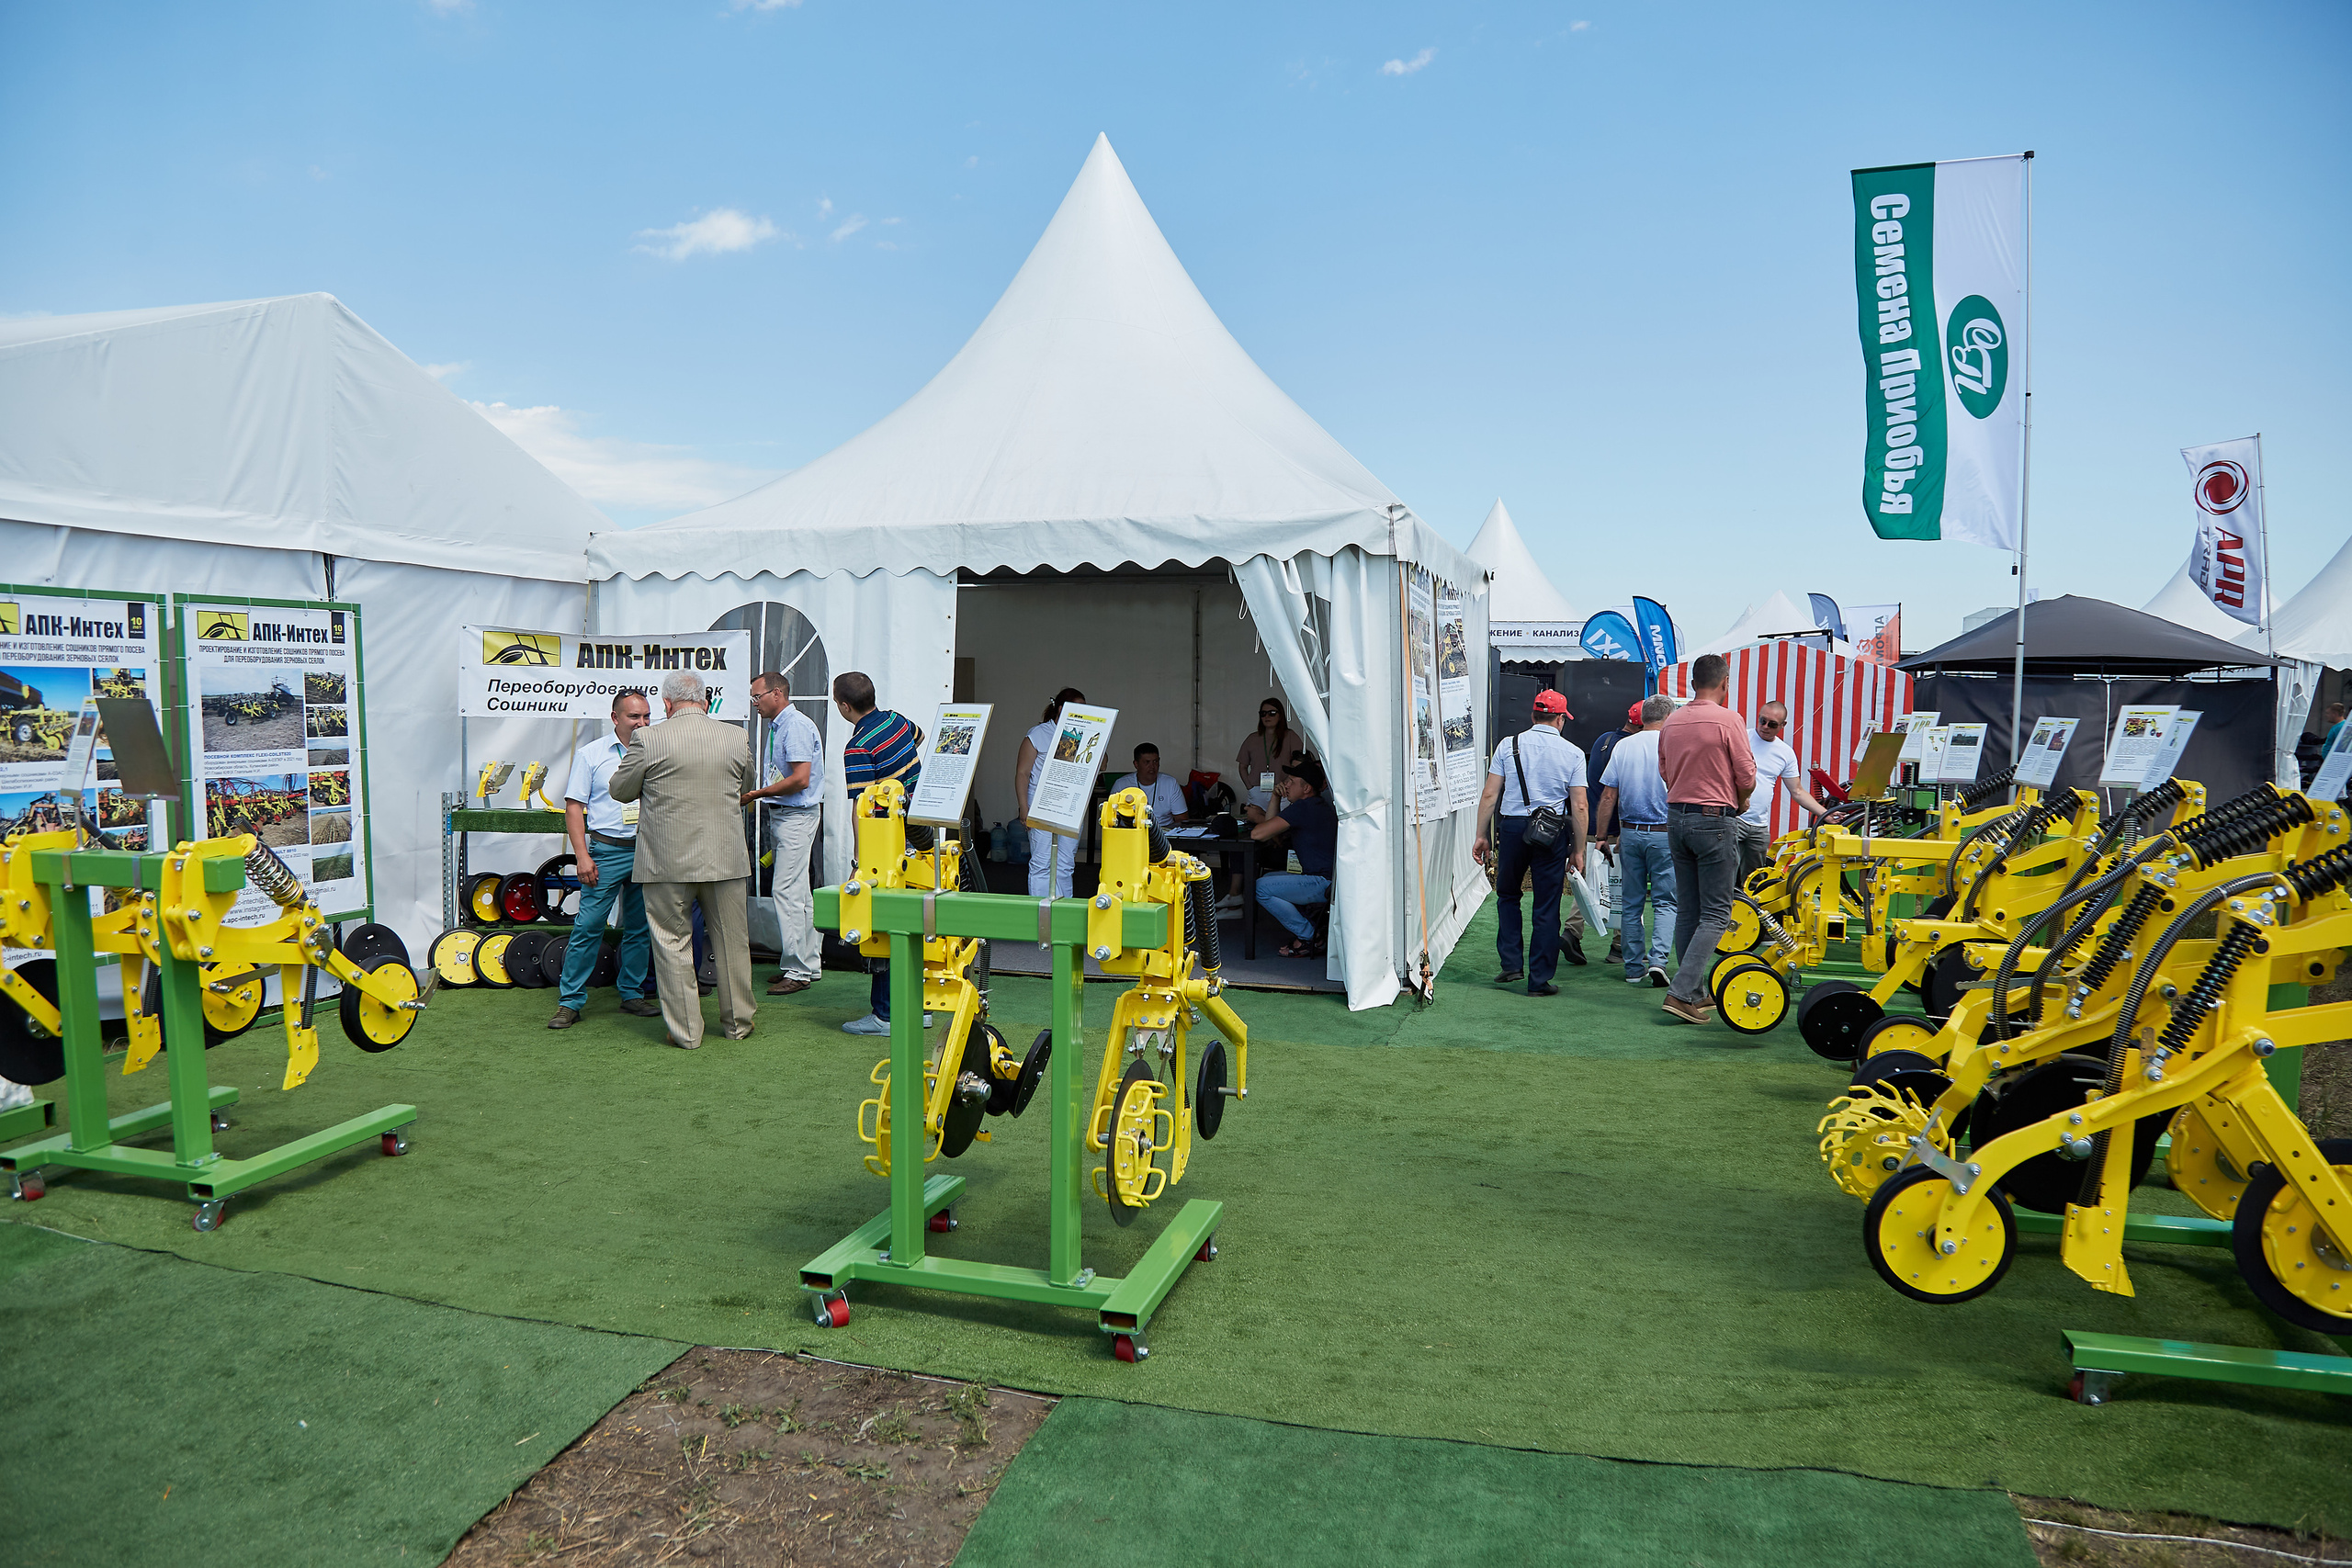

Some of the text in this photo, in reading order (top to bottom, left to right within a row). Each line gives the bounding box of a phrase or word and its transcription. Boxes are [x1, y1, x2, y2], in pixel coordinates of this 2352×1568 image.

[1871, 193, 1923, 514] Семена Приобья
[2214, 525, 2245, 609] APR
[26, 614, 124, 639] АПК-Интех
[130, 616, 142, 626] 10
[333, 624, 343, 632] 10
[253, 622, 329, 644] АПК-Интех
[18, 642, 65, 651] ИЗГОТОВЛЕНИЕ
[65, 643, 97, 652] СОШНИКОВ
[97, 645, 124, 653] ПРЯМОГО
[124, 645, 146, 654] ПОСЕВА
[198, 645, 243, 653] ПРОЕКТИРОВАНИЕ
[247, 647, 282, 655] ИЗГОТОВЛЕНИЕ
[283, 648, 308, 656] СОШНИКОВ
[1649, 625, 1668, 670] MNO
[2, 652, 120, 663] ПЕРЕОБОРУДОВАНИЯ ЗЕРНОВЫХ СЕЯЛОК
[223, 655, 234, 663] ДЛЯ
[235, 655, 283, 664] ПЕРЕОБОРУДОВАНИЯ
[576, 642, 727, 671] АПК-Интех
[488, 697, 568, 712] Сошники
